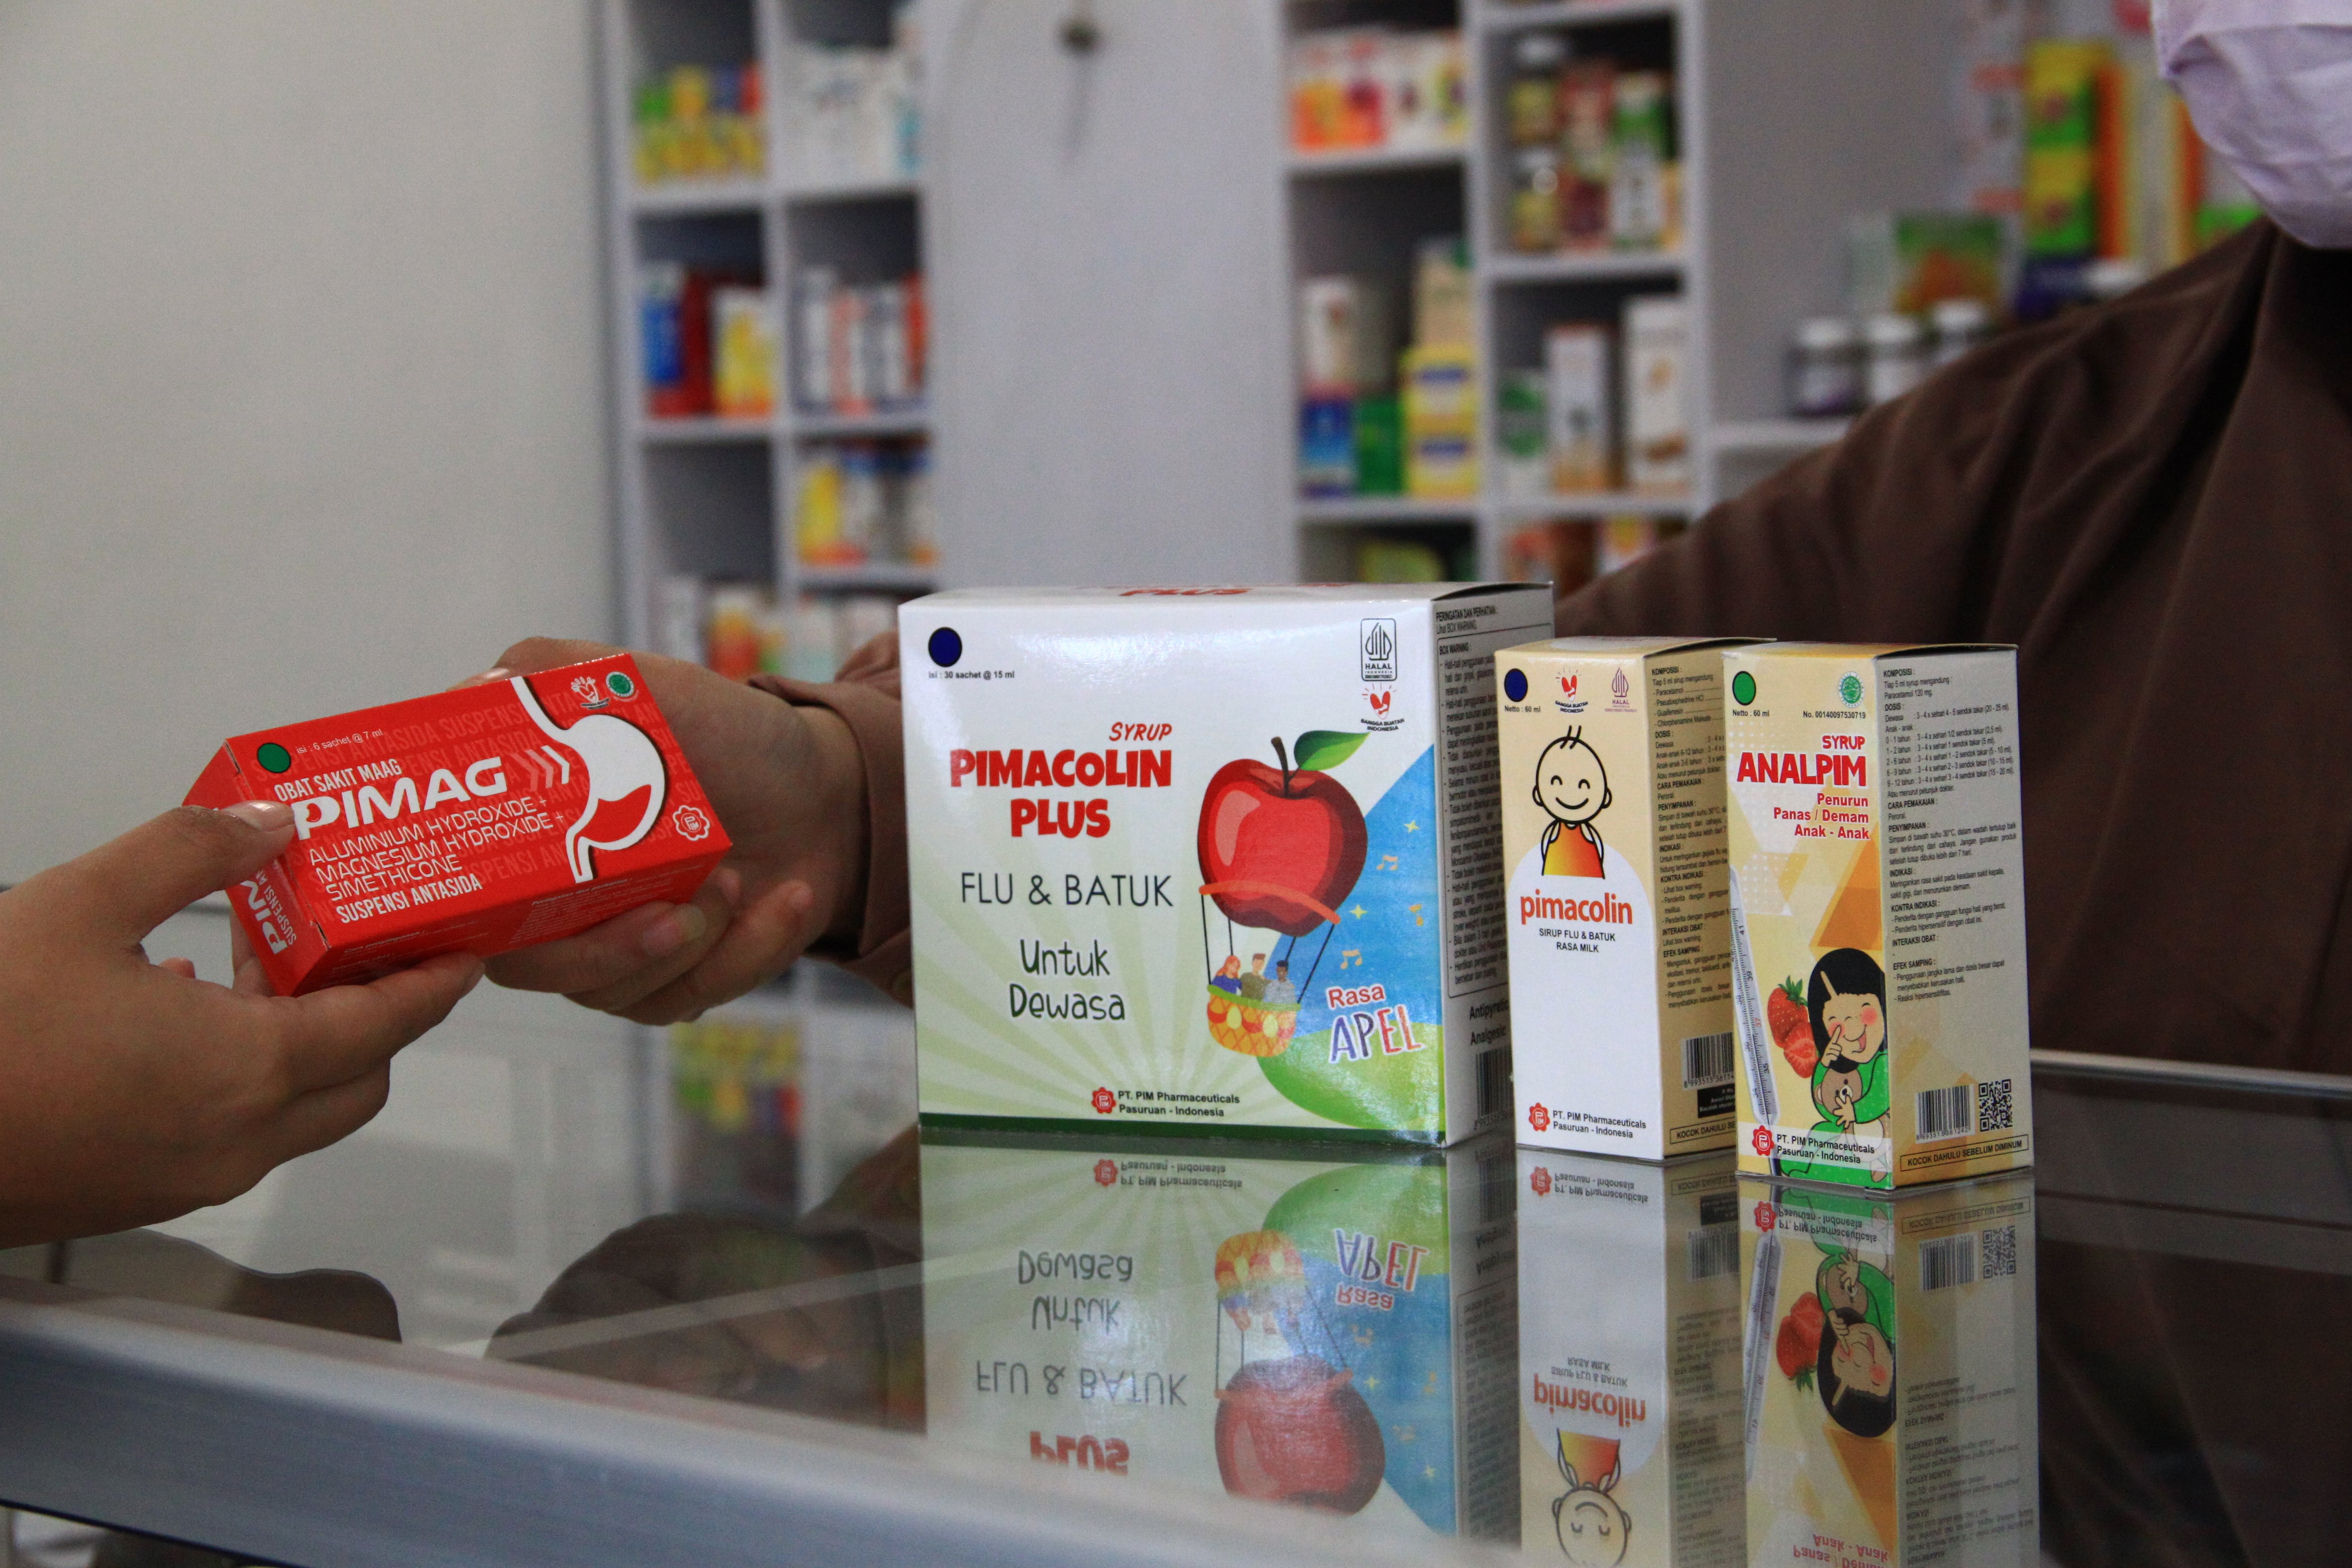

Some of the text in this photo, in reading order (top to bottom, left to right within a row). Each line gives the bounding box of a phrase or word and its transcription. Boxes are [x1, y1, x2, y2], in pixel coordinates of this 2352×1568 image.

[1436, 608, 1473, 622] PERINGATAN DAN
[1447, 622, 1456, 632] BOX
[1456, 620, 1477, 631] WARNING
[1439, 642, 1469, 655] BOX WARNING
[983, 671, 991, 680] @
[1652, 666, 1679, 676] KOMPOSISI
[1883, 668, 1912, 678] KOMPOSISI
[1920, 677, 1949, 686] mengandung
[1884, 690, 1913, 699] Paracetamol
[1885, 703, 1901, 711] DOSIS
[322, 735, 350, 749] sachet
[352, 733, 362, 742] @
[364, 732, 370, 740] 7
[373, 729, 383, 737] ml
[1109, 722, 1172, 741] SYRUP
[1822, 735, 1865, 750] SYRUP
[950, 749, 1172, 788] PIMACOLIN
[1737, 752, 1866, 786] ANALPIM
[274, 759, 402, 801] OBAT SAKIT MAAG
[1657, 778, 1702, 790] CARA PEMAKAIAN
[291, 757, 507, 840] PIMAG
[1658, 800, 1693, 811] PENYIMPANAN
[1817, 792, 1868, 807] Penurun
[1888, 798, 1935, 810] CARA PEMAKAIAN
[1010, 798, 1111, 838] PLUS
[1774, 807, 1869, 823] Panas / Demam
[309, 824, 424, 866] ALUMINIUM
[426, 796, 538, 836] HYDROXIDE
[1794, 824, 1870, 839] Anak Anak
[1889, 822, 1926, 833] PENYIMPANAN
[316, 839, 441, 884] MAGNESIUM
[443, 812, 553, 853] HYDROXIDE
[1660, 843, 1681, 853] INDIKASI
[326, 854, 463, 901] SIMETHICONE
[1661, 870, 1704, 883] KONTRA INDIKASI
[1890, 868, 1912, 878] INDIKASI
[962, 873, 1174, 907] FLU & BATUK
[337, 873, 483, 923] SUSPENSI ANTASIDA
[1520, 889, 1633, 925] pimacolin
[1891, 900, 1937, 912] KONTRA INDIKASI
[264, 885, 296, 945] SUSPENSI
[1539, 928, 1562, 937] SIRUP
[1565, 930, 1579, 939] FLU
[1589, 932, 1616, 941] BATUK
[1663, 923, 1703, 936] INTERAKSI OBAT
[1557, 942, 1599, 952] RASA MILK
[1892, 936, 1920, 947] INTERAKSI
[1020, 939, 1110, 977] Untuk
[1664, 945, 1700, 958] EFEK SAMPING
[1893, 958, 1932, 970] EFEK SAMPING
[1010, 983, 1125, 1021] Dewasa
[1328, 986, 1385, 1008] Rasa
[1331, 1006, 1422, 1062] APEL
[1470, 1026, 1506, 1046] Analgesic
[1118, 1091, 1240, 1104] PT. PIM Pharmaceuticals
[1119, 1104, 1224, 1117] Pasuruan Indonesia
[1553, 1110, 1647, 1129] PT. PIM Pharmaceuticals
[1553, 1121, 1633, 1138] Pasuruan Indonesia
[1677, 1129, 1699, 1139] KOCOK
[1701, 1123, 1726, 1134] DAHULU
[1759, 1135, 1768, 1148] PIM
[1777, 1134, 1874, 1154] PT. PIM Pharmaceuticals
[1777, 1145, 1861, 1164] Pasuruan Indonesia
[1908, 1140, 2022, 1166] KOCOK DAHULU SEBELUM DIMINUM
